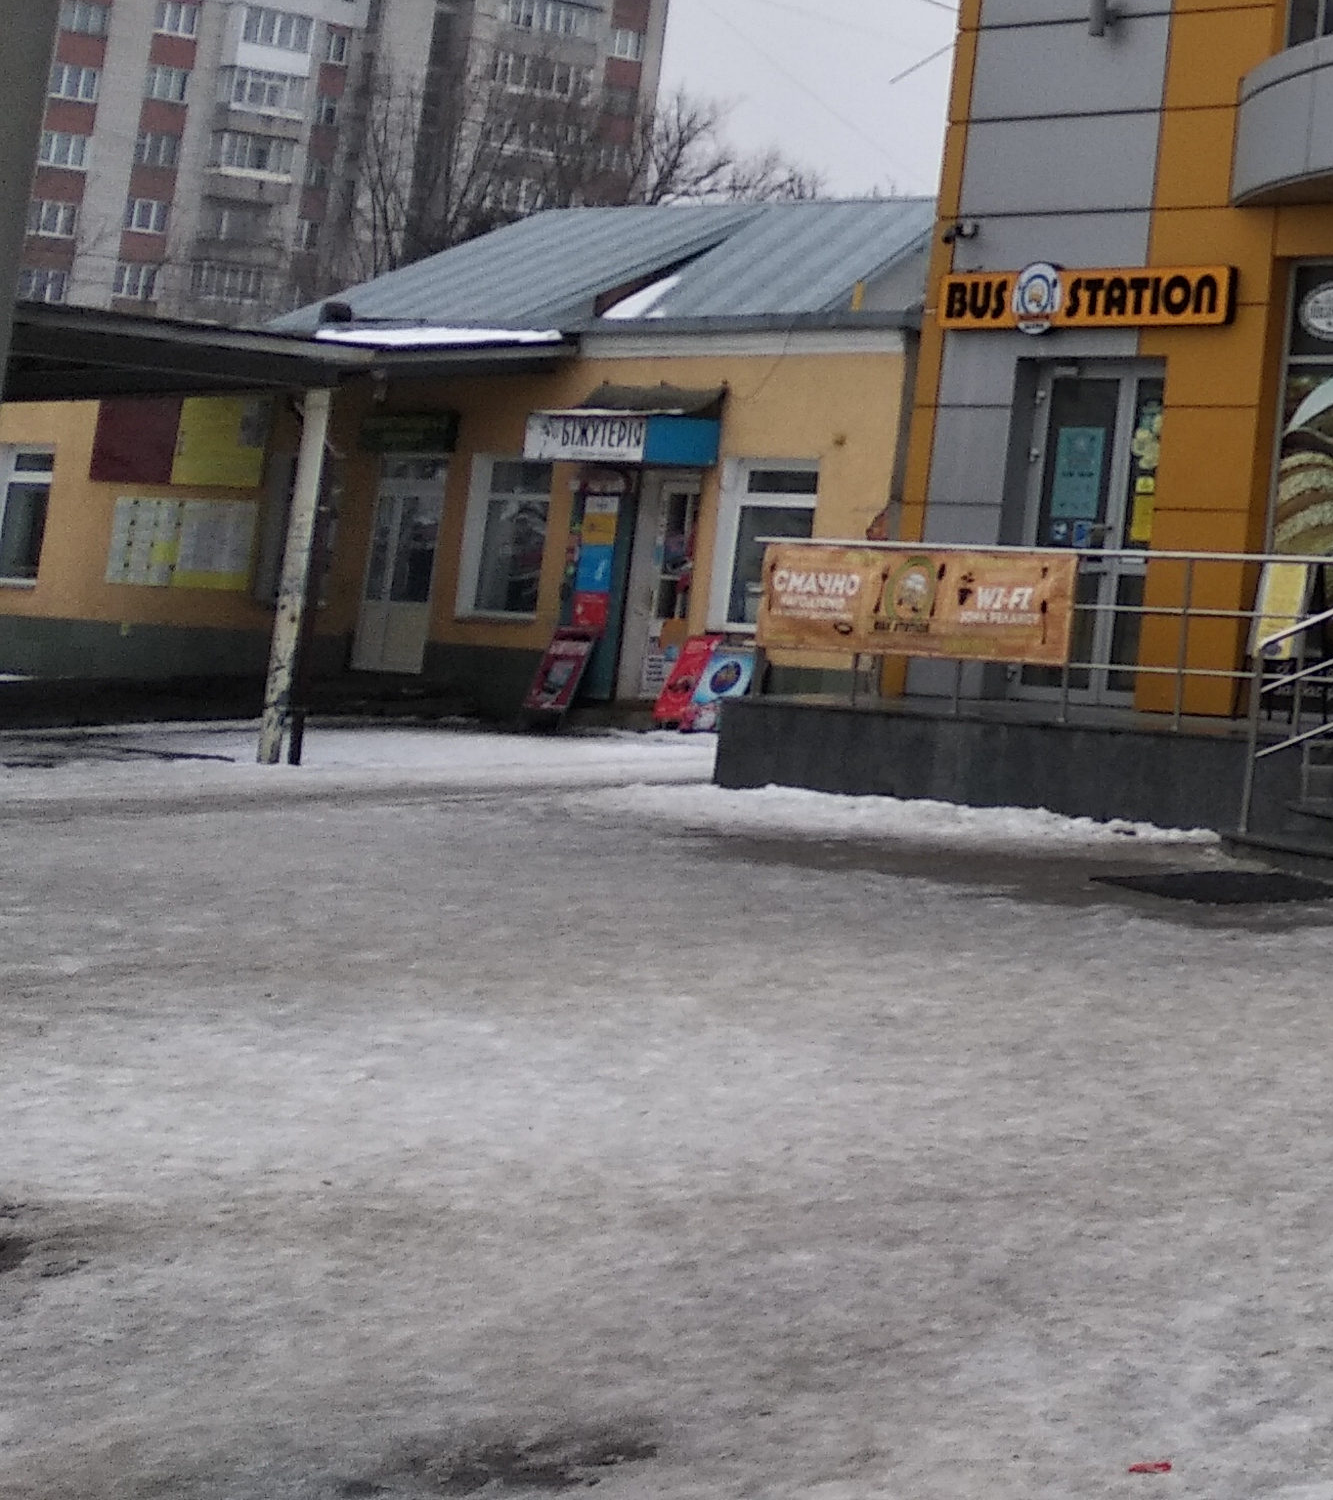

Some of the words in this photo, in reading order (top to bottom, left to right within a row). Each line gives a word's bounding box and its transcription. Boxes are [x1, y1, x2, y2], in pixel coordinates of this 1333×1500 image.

[945, 279, 1007, 320] BUS
[1065, 273, 1217, 319] STATION
[561, 417, 643, 448] БІЖУТЕРІЯ
[773, 570, 860, 597] СМАЧНО
